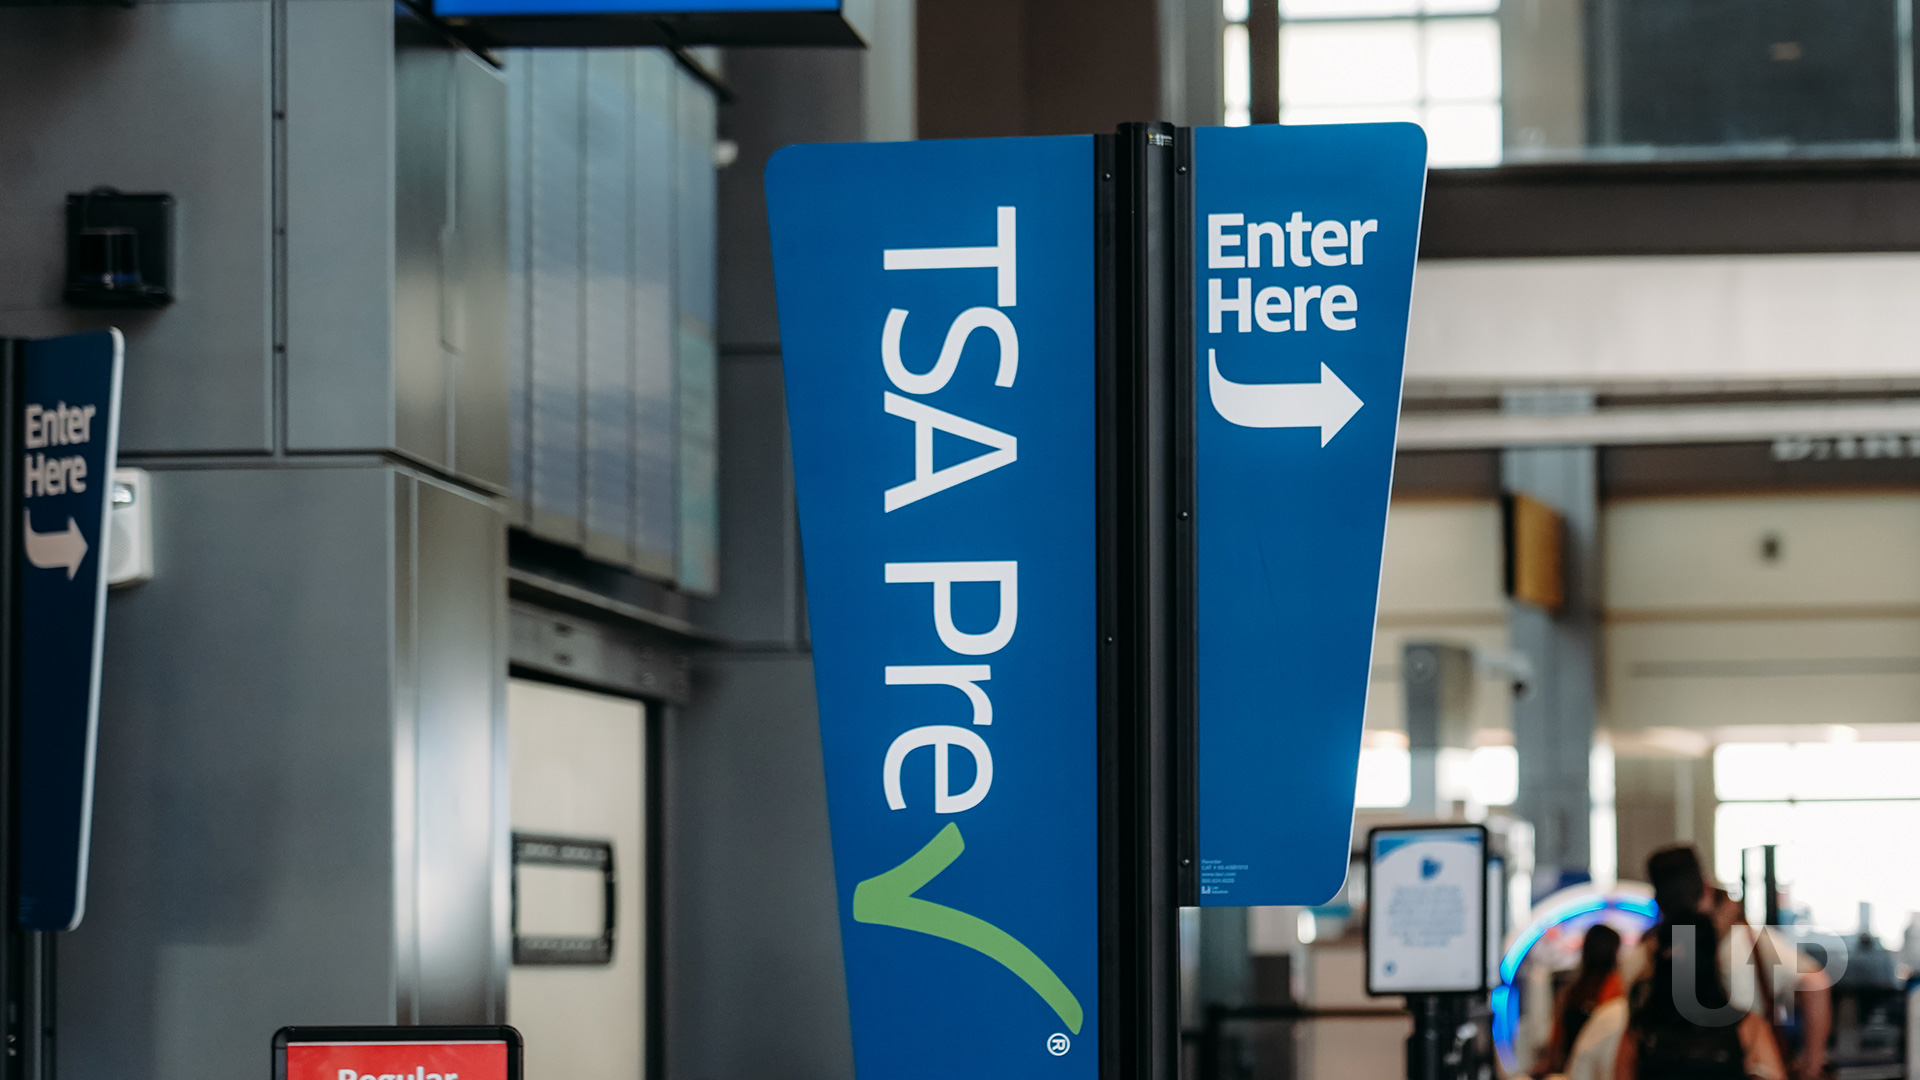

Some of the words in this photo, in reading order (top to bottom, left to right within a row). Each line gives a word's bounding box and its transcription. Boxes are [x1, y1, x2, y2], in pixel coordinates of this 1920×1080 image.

[1207, 211, 1378, 269] Enter
[1208, 277, 1358, 334] Here
[882, 206, 1018, 513] TSA
[25, 401, 96, 449] Enter
[25, 453, 88, 498] Here
[883, 560, 1018, 814] Pre
